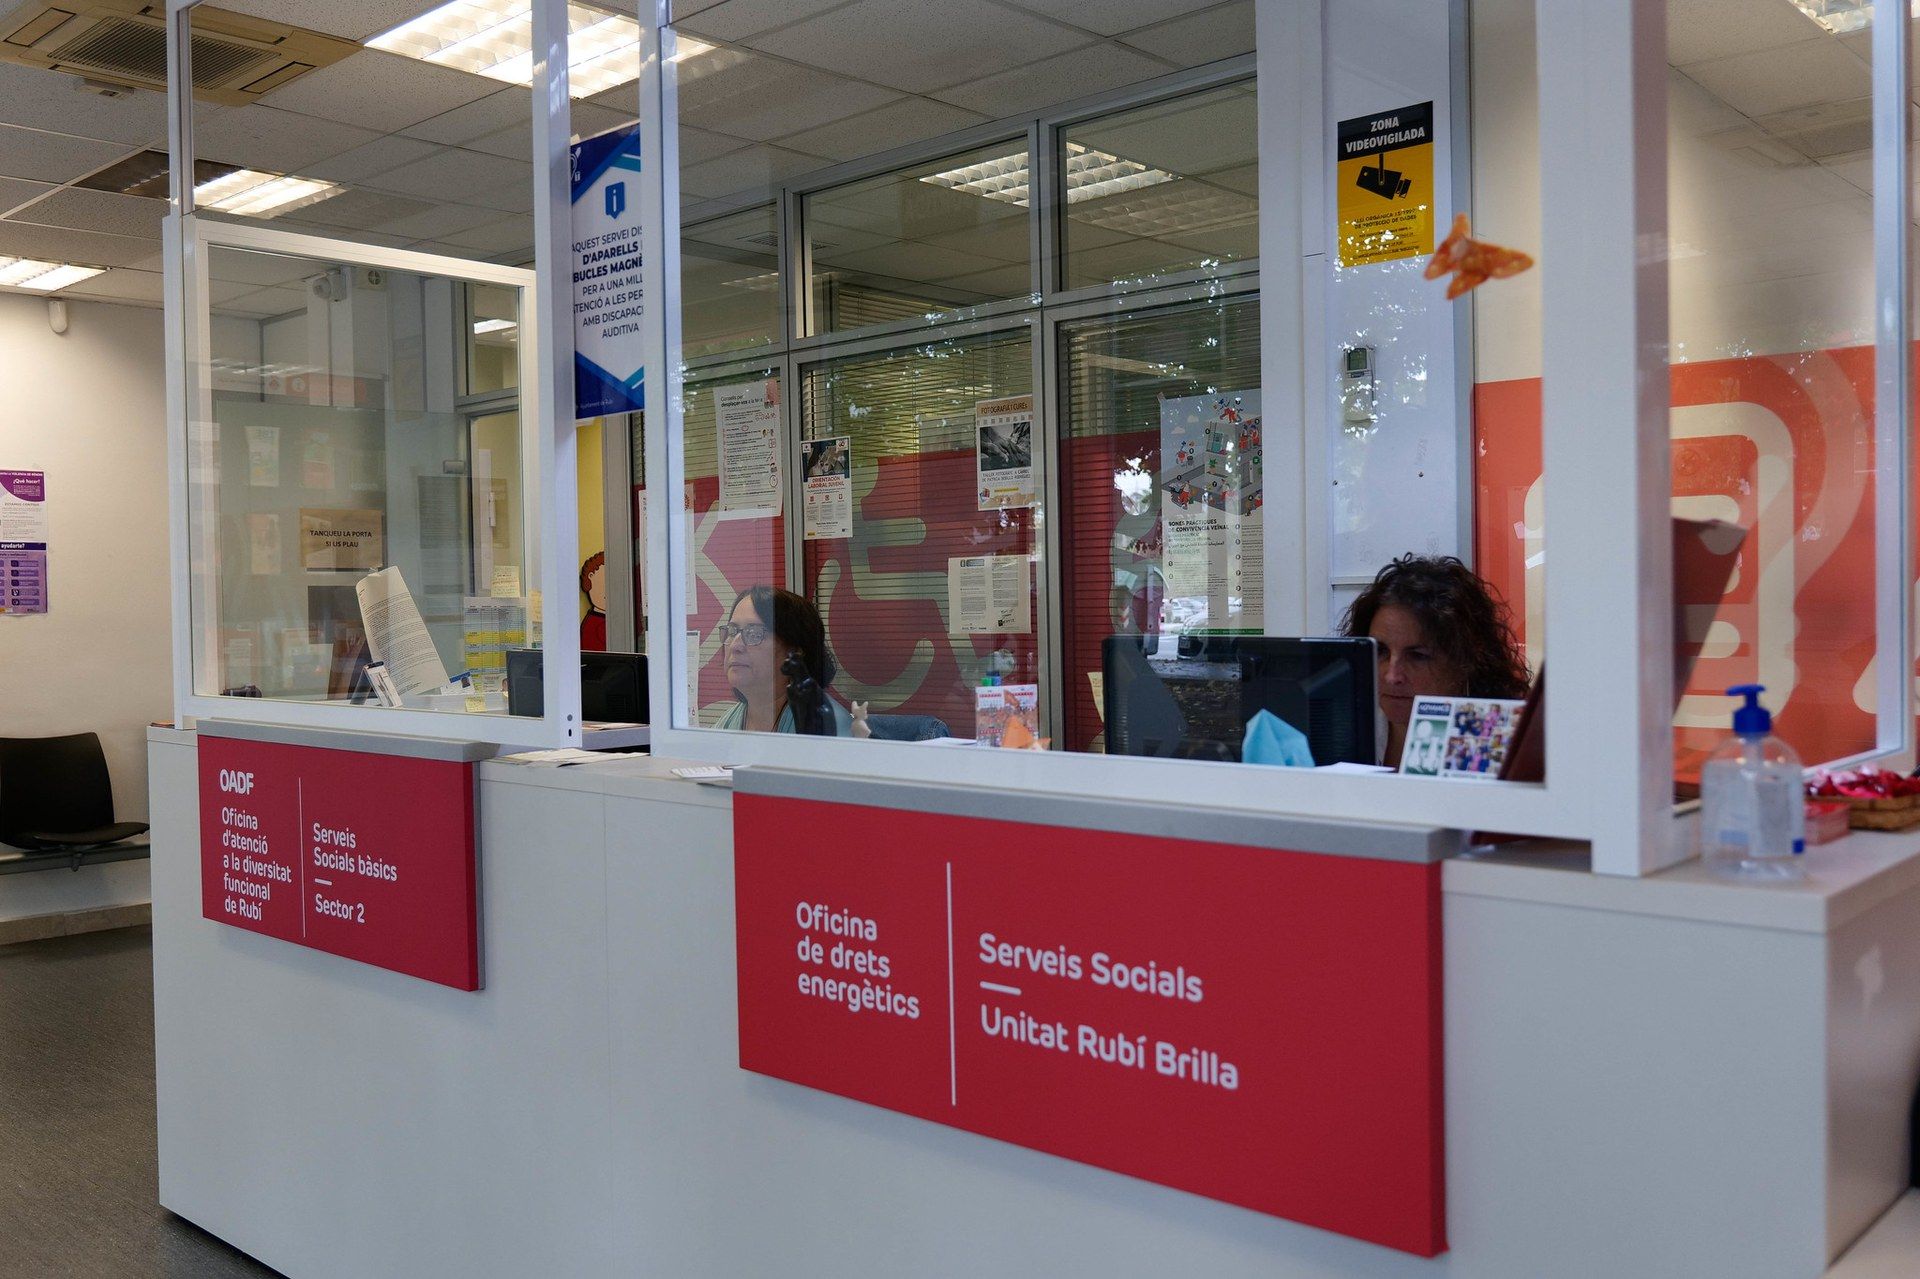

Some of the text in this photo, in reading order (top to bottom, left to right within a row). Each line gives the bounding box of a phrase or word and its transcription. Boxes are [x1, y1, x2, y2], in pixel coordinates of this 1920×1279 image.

[1370, 116, 1400, 132] ZONA
[1345, 126, 1426, 153] VIDEOVIGILADA
[602, 230, 629, 245] SERVEI
[582, 241, 639, 265] D'APARELLS
[573, 265, 608, 283] BUCLES
[582, 284, 598, 297] PER
[600, 283, 606, 292] A
[607, 279, 625, 291] UNA
[605, 297, 611, 307] A
[612, 292, 627, 305] LES
[582, 314, 600, 327] AMB
[602, 323, 640, 338] AUDITIVA
[309, 529, 342, 538] TANQUEU
[219, 768, 254, 795] OADF
[221, 806, 258, 830] Oficina
[222, 829, 268, 855] d'atenció
[313, 822, 356, 849] Serveis
[223, 852, 292, 883] a la diversitat
[313, 846, 398, 882] Socials bàsics
[223, 872, 271, 900] funcional
[224, 895, 262, 921] de Rubí
[315, 893, 365, 924] Sector 2
[796, 901, 878, 941] Oficina
[797, 934, 891, 978] de drets
[979, 932, 1204, 1003] Serveis Socials
[798, 972, 920, 1019] energètics
[980, 1003, 1239, 1090] Unitat Rubí Brilla
